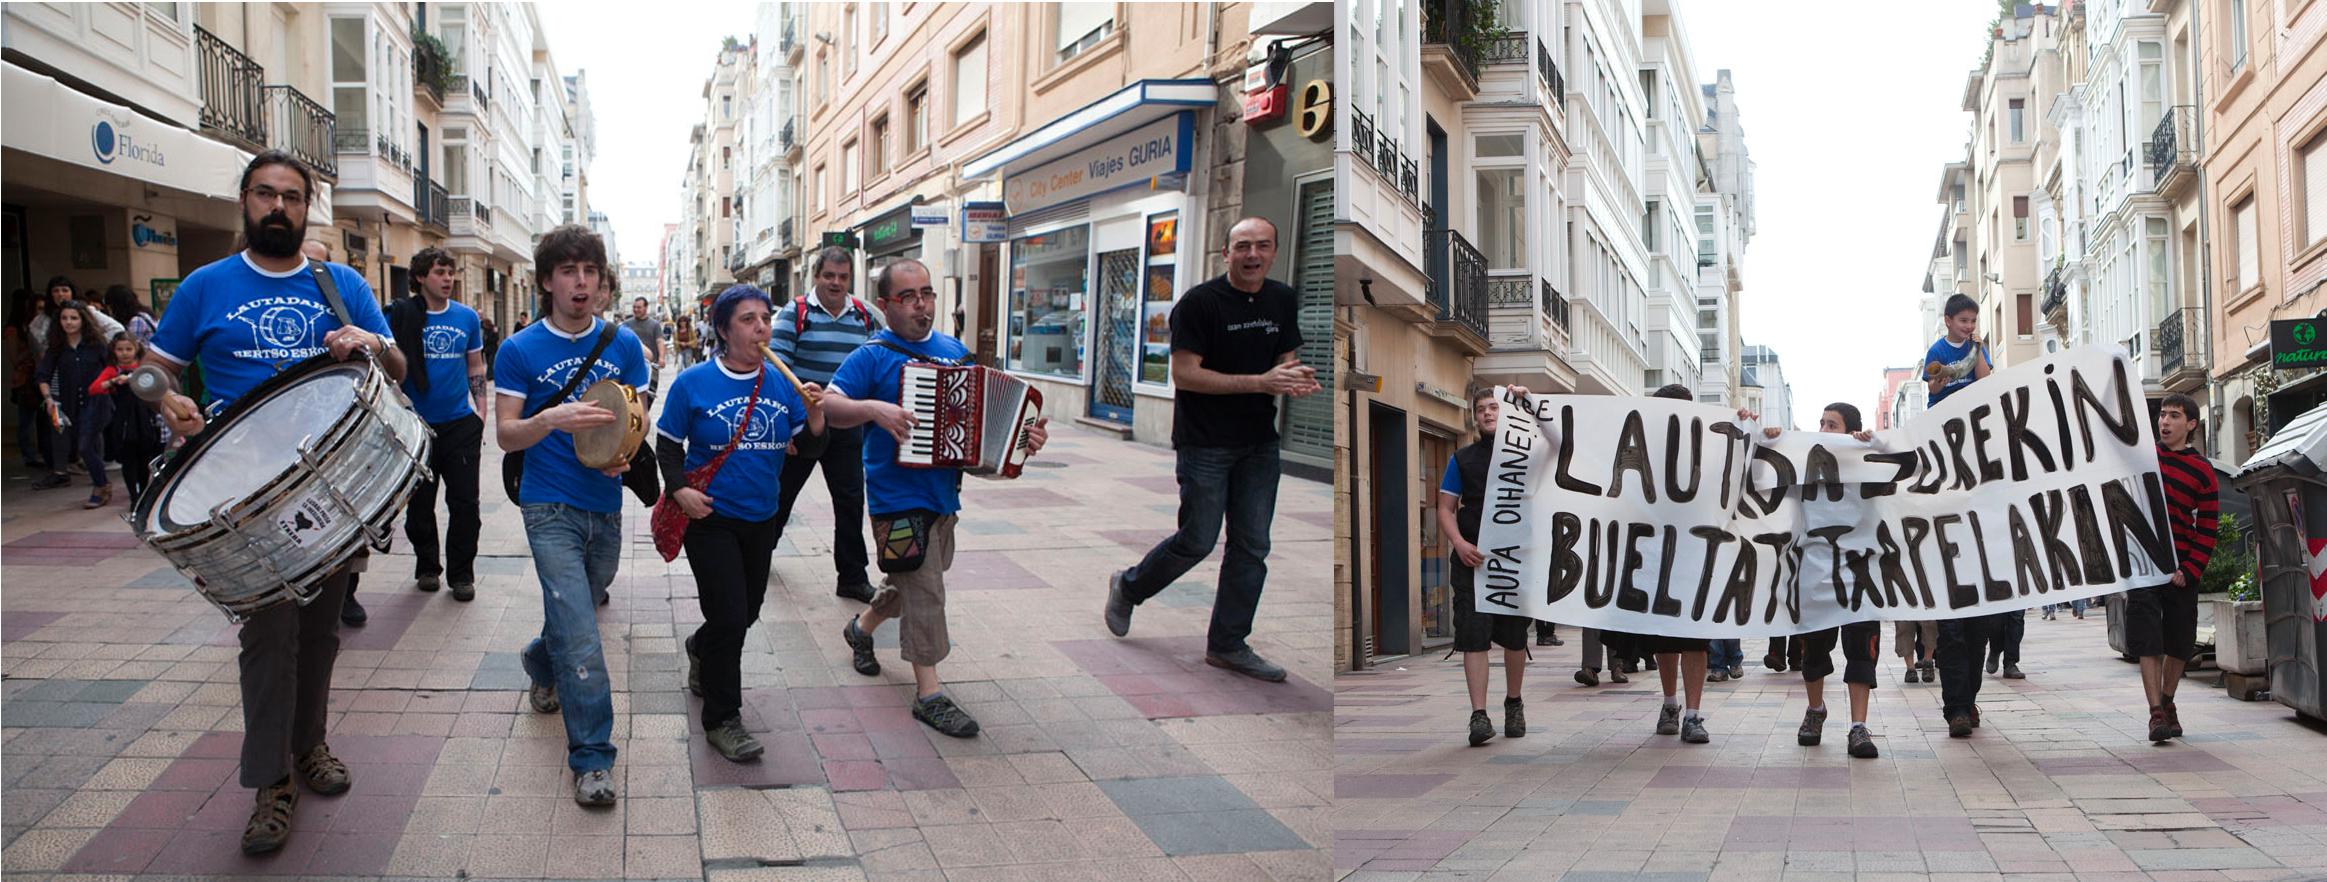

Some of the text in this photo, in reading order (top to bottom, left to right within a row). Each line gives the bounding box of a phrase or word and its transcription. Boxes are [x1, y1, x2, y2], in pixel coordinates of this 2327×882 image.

[118, 133, 165, 167] Florida
[1029, 134, 1173, 199] City Center Viajes GURIA
[536, 356, 621, 383] LAUTAAKO
[1485, 545, 1521, 609] AUPA
